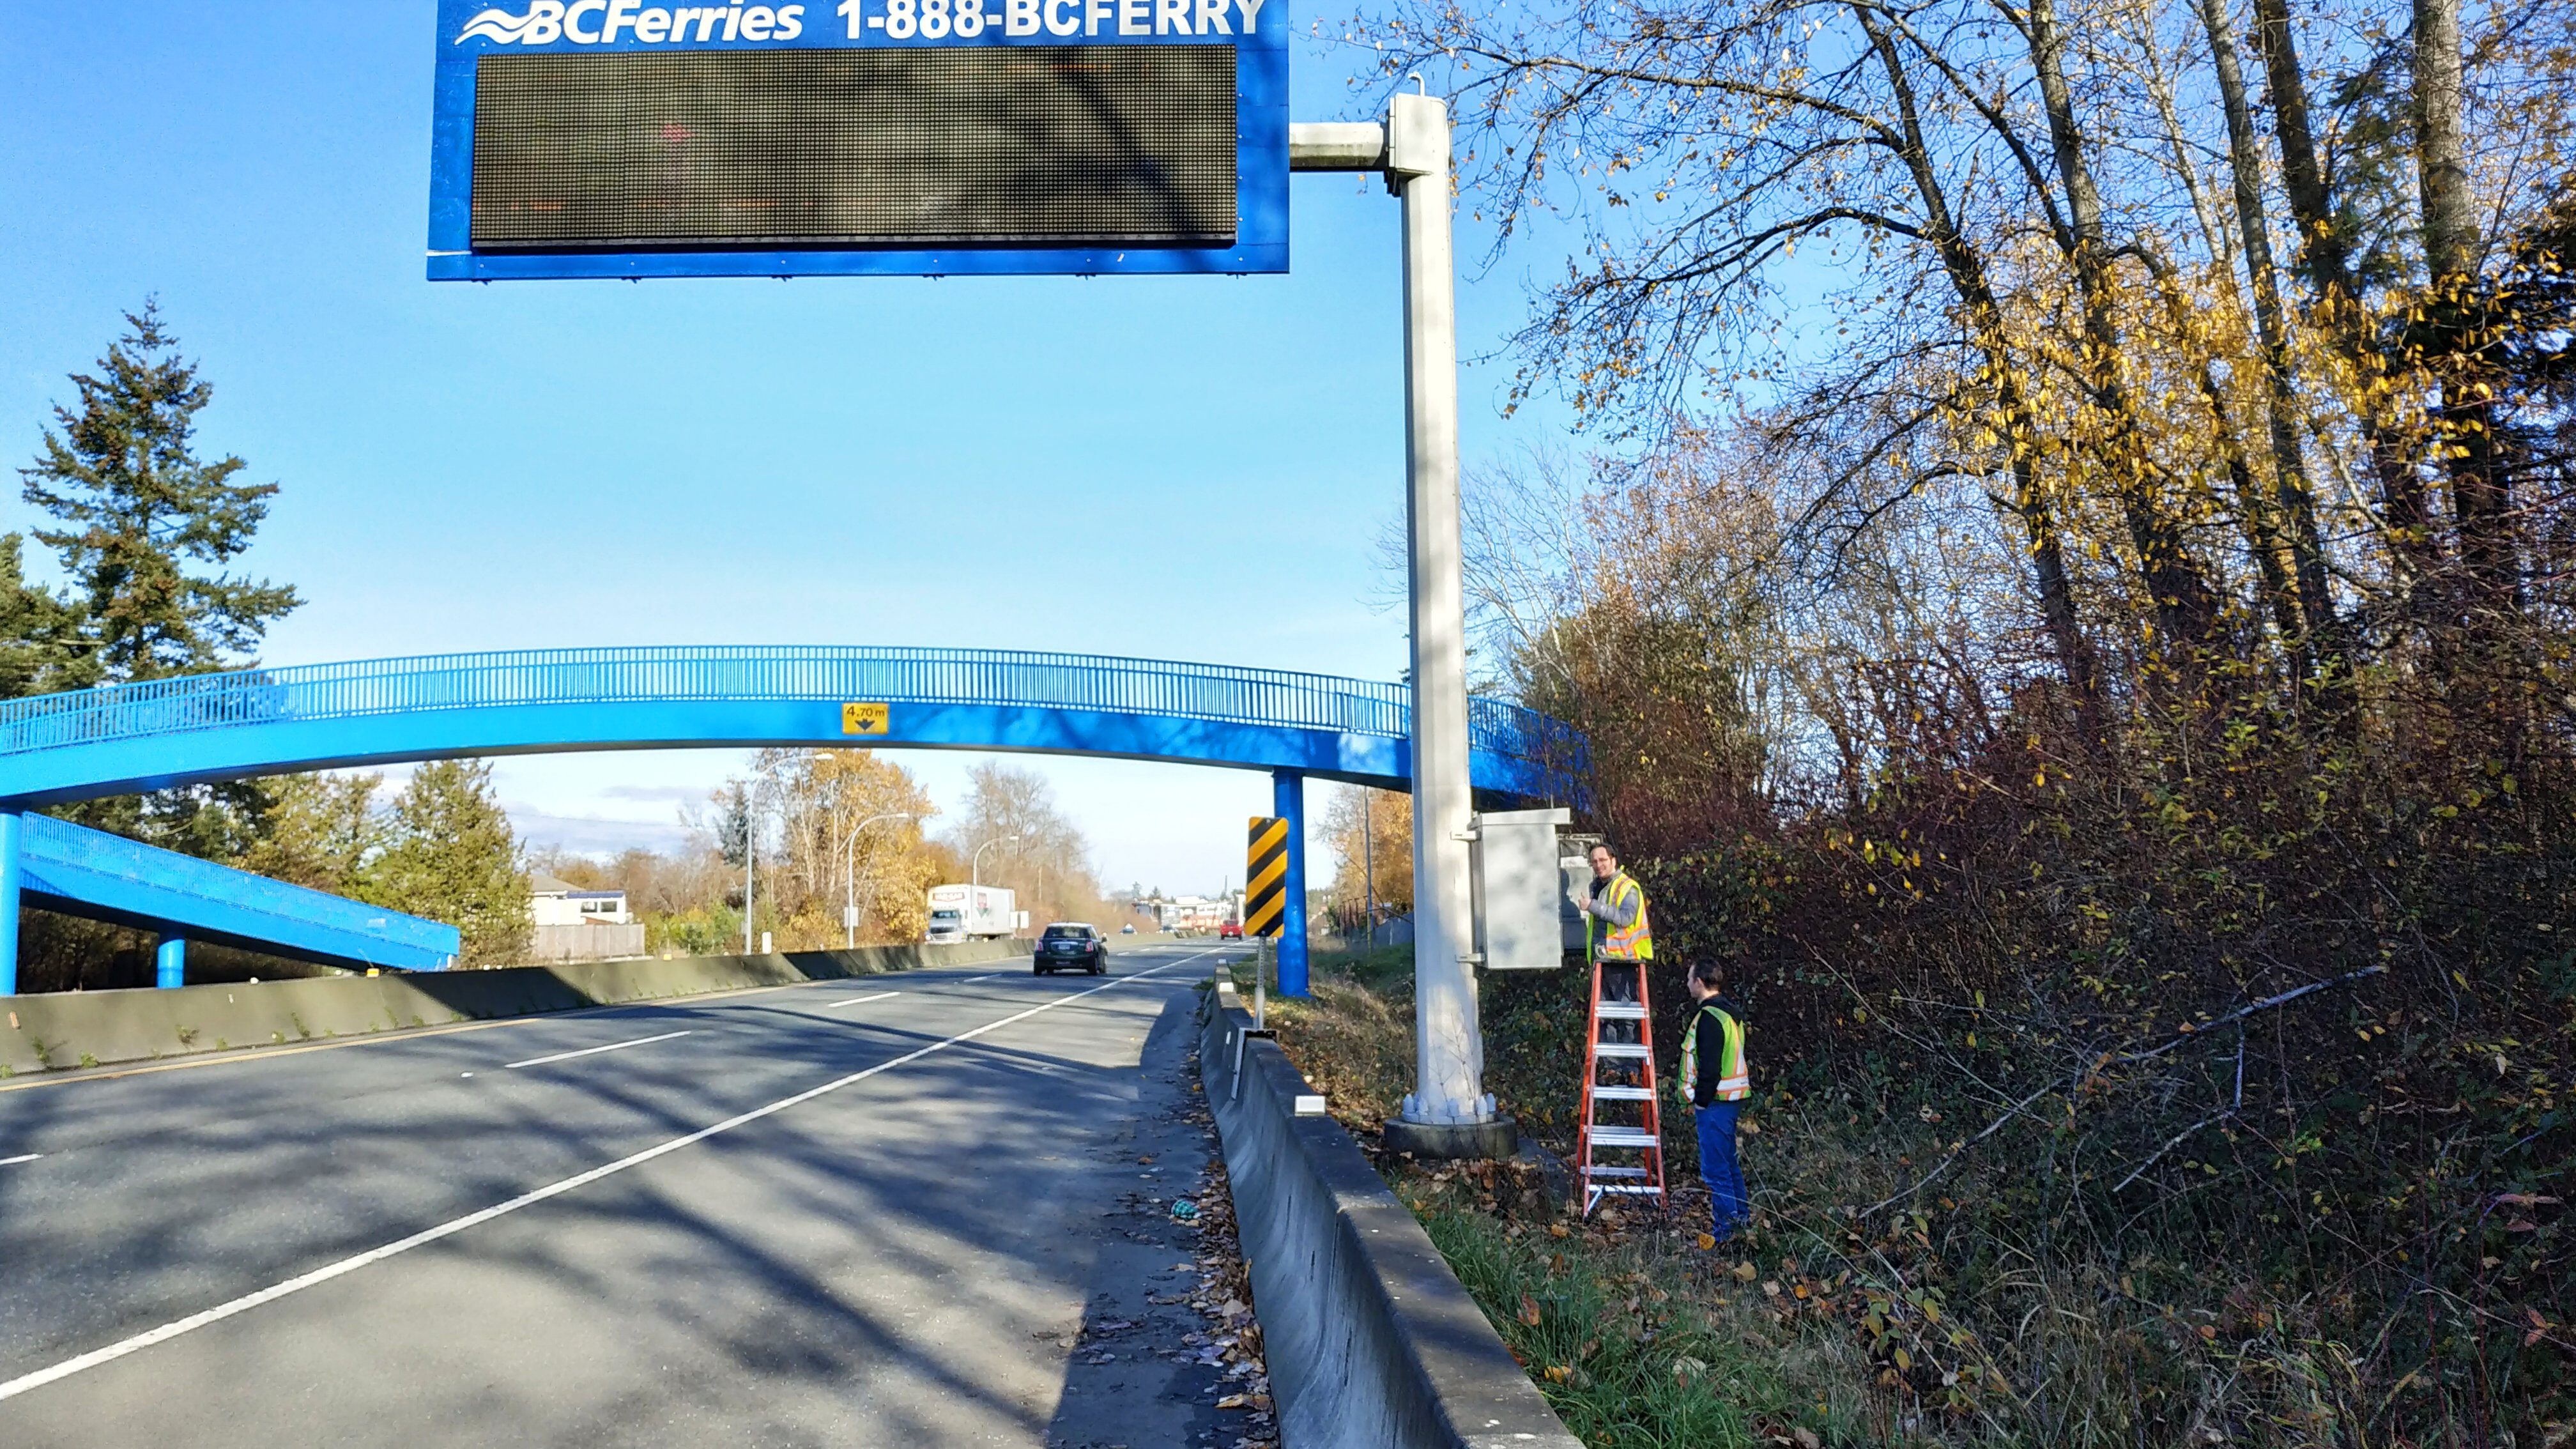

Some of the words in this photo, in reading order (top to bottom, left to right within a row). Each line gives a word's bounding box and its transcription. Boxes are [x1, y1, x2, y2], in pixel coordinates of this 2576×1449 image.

[521, 0, 804, 44] BCFerries
[836, 0, 1264, 39] 1-888-BCFERRY
[847, 705, 873, 717] 4.70
